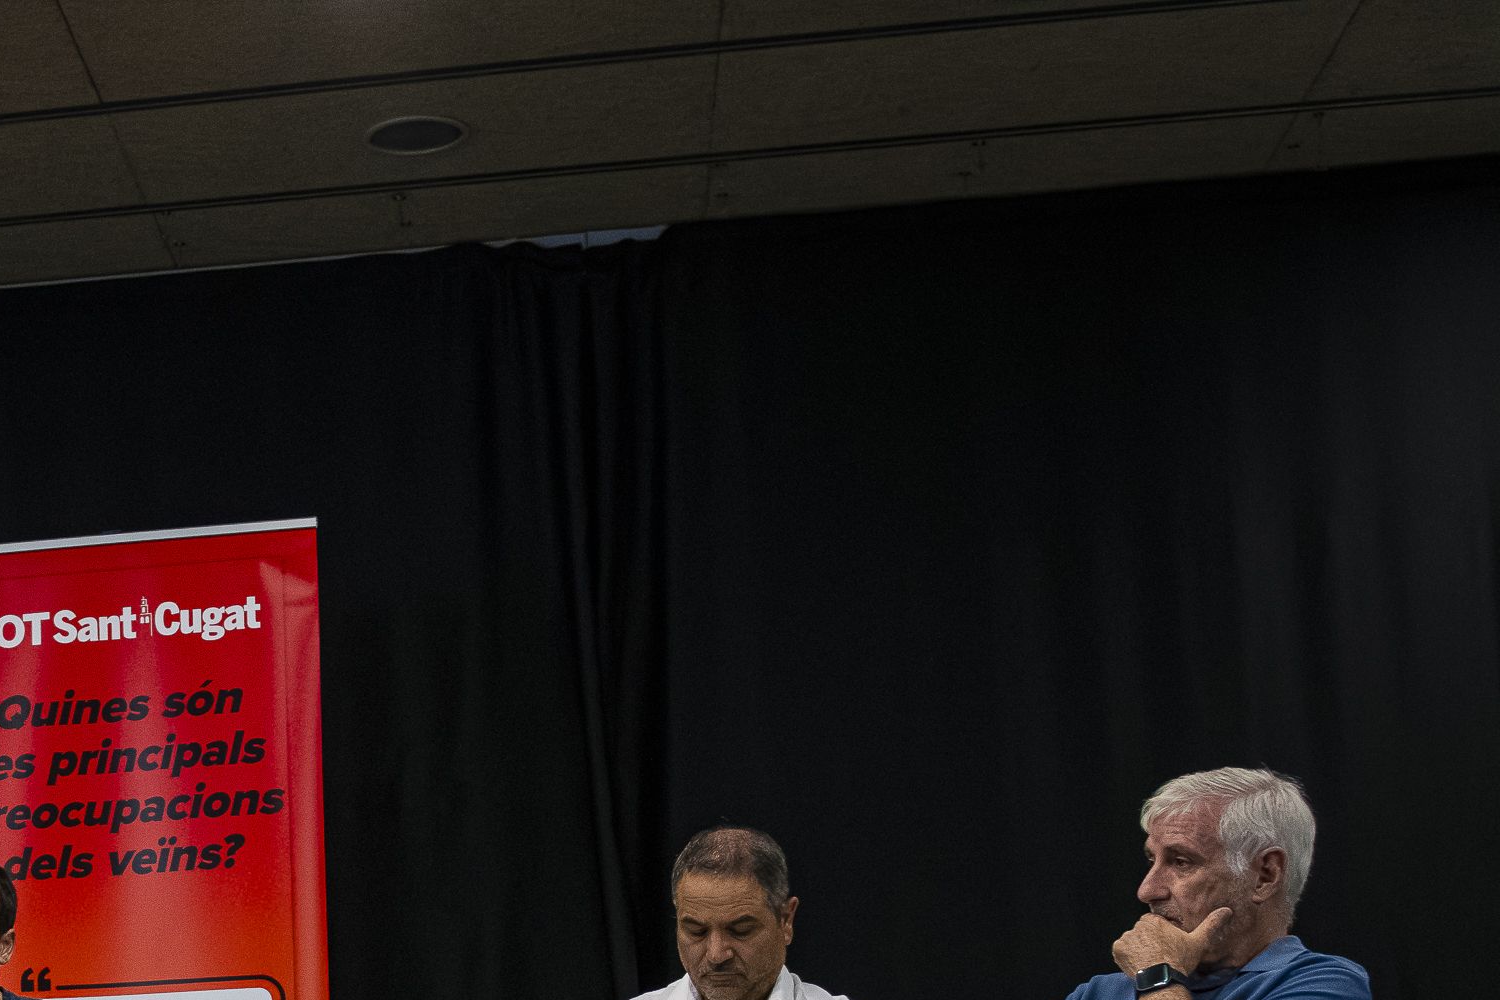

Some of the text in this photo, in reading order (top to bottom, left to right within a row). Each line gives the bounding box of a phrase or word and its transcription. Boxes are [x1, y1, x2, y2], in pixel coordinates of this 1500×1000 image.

[53, 606, 137, 644] Sant
[154, 596, 261, 641] Cugat
[162, 680, 244, 718] són
[47, 731, 267, 786] principals
[3, 833, 246, 881] dels veïns?
